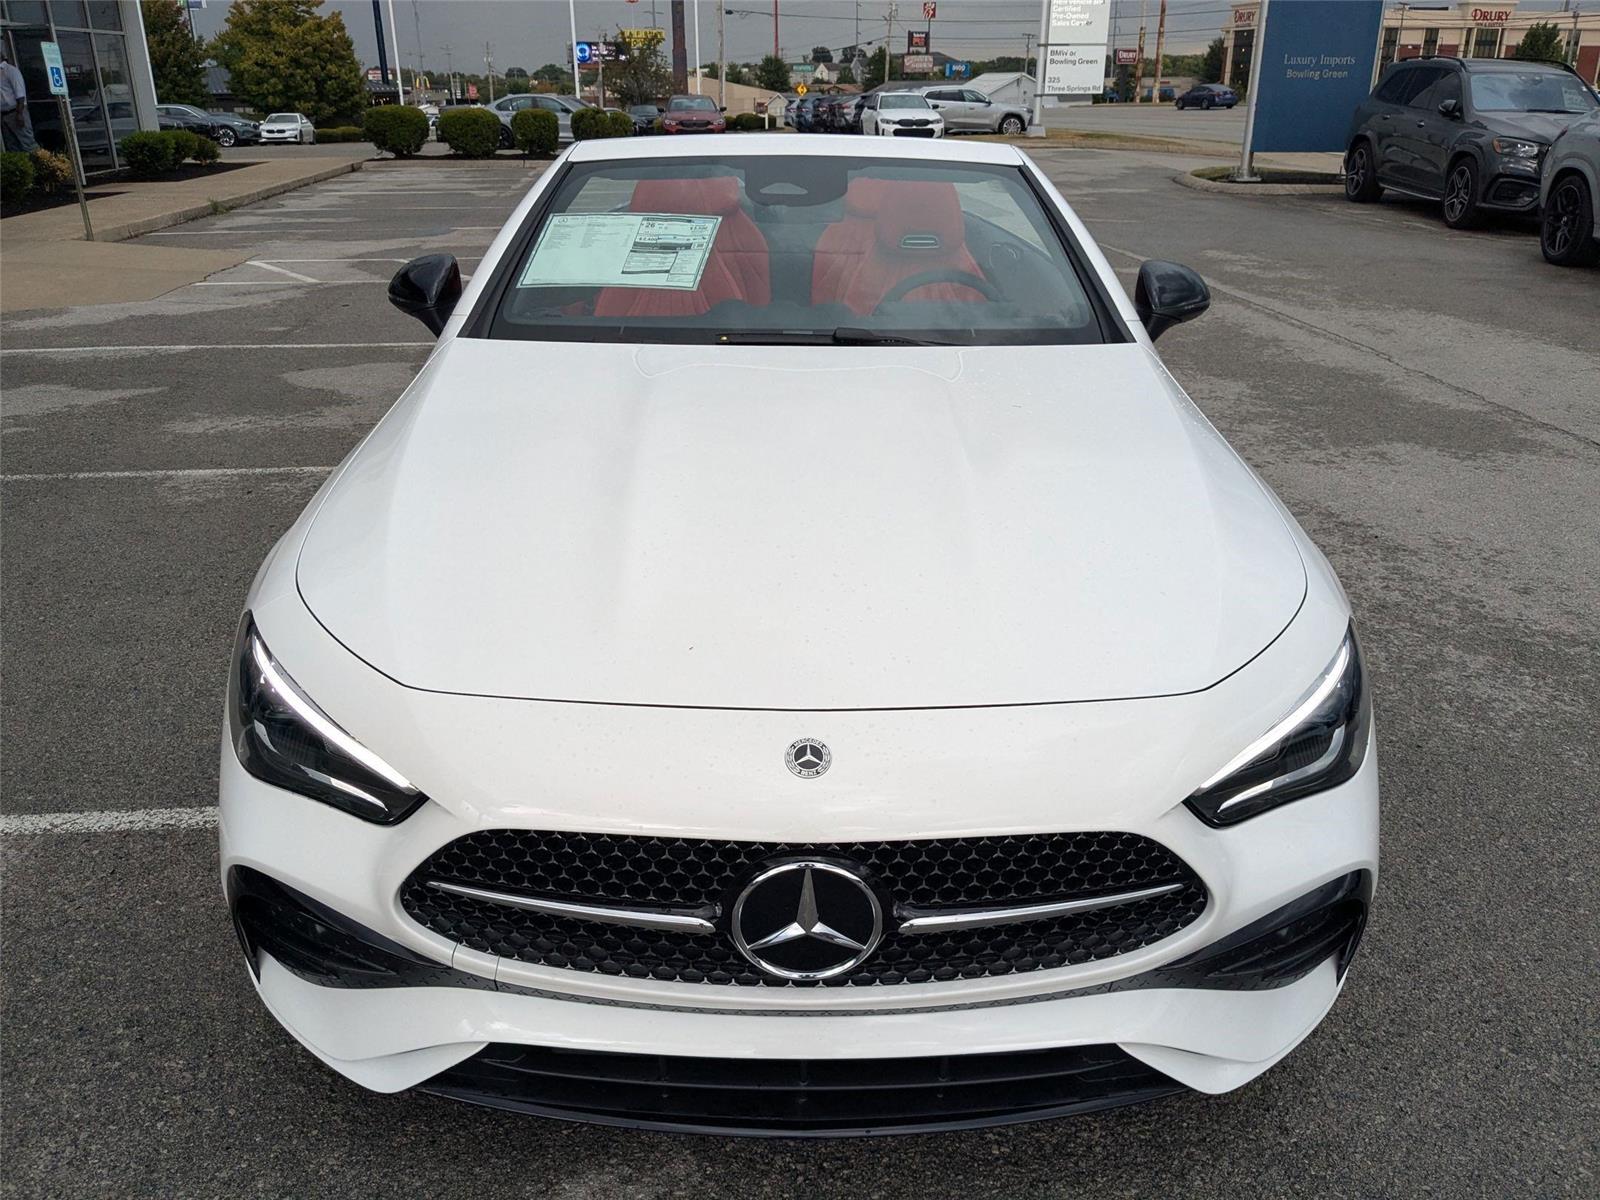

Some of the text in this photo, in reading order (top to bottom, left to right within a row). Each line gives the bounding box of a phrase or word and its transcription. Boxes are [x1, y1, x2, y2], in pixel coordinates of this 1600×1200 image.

[1472, 8, 1511, 21] DRURY
[1049, 58, 1076, 66] Bowling
[1284, 54, 1356, 67] Luxury Imports
[1286, 69, 1348, 80] Bowling Green
[1066, 85, 1091, 93] Springs
